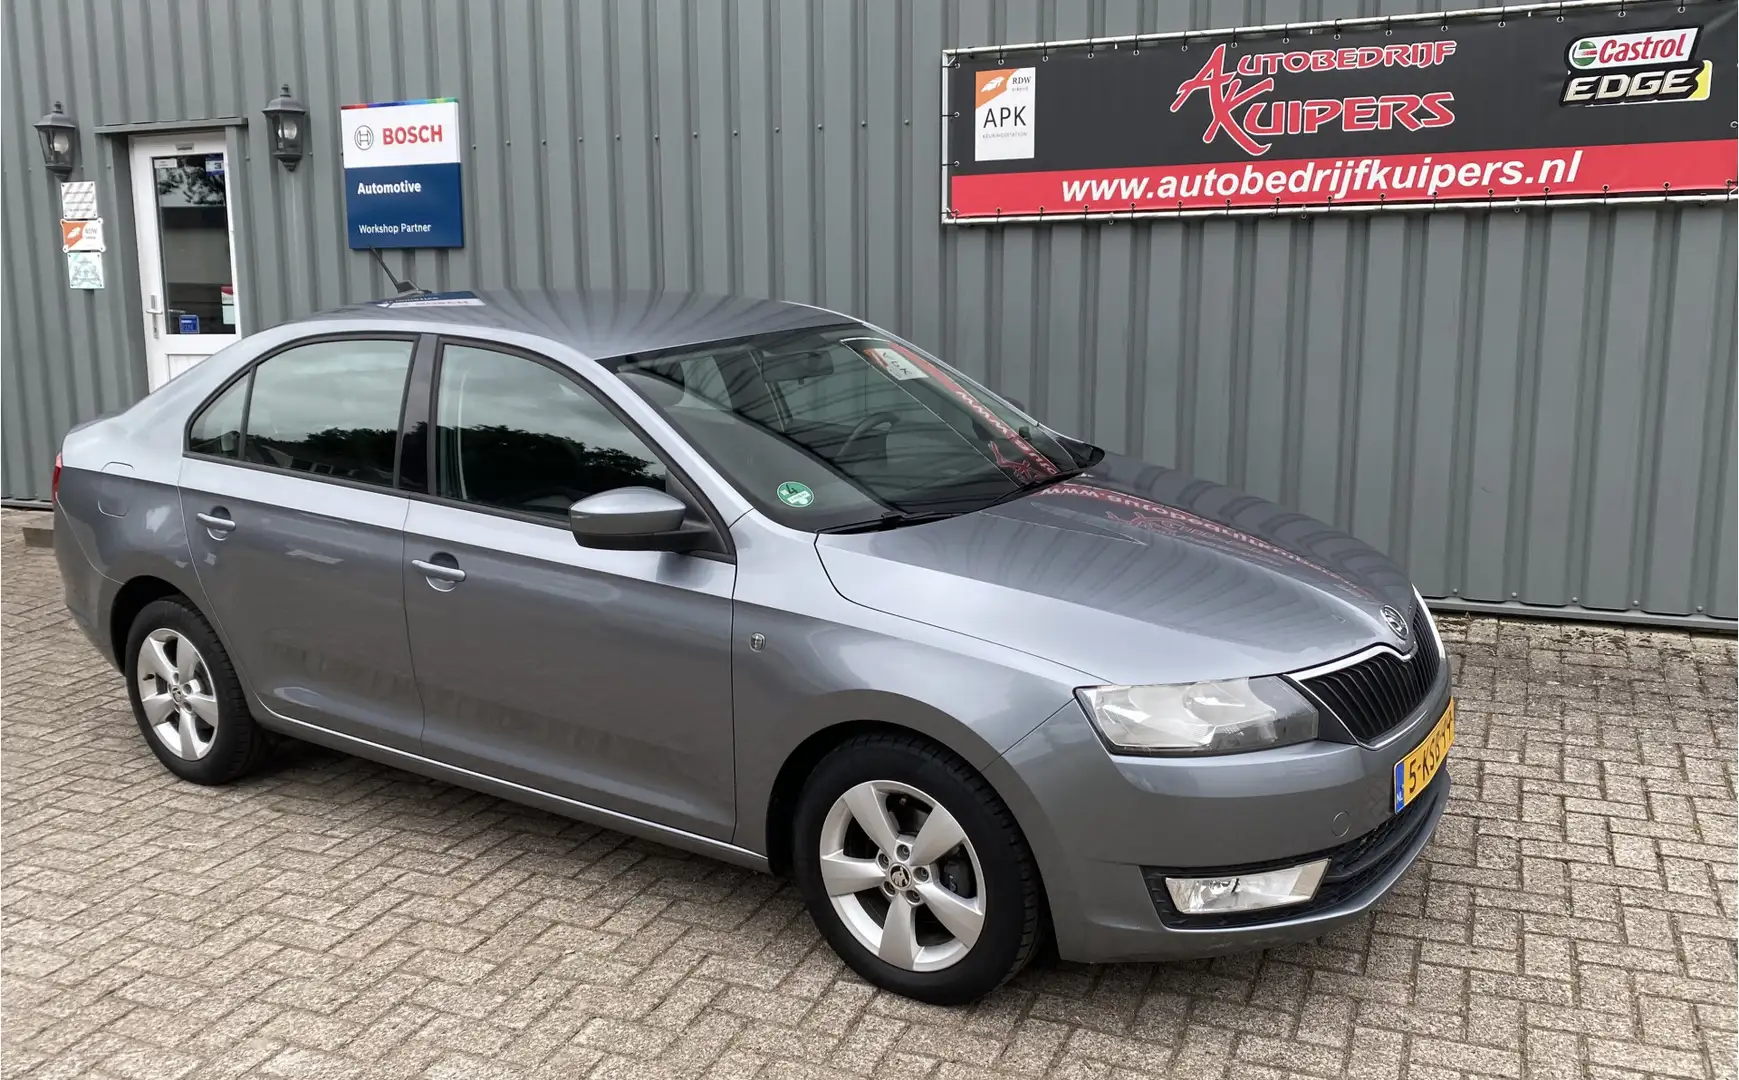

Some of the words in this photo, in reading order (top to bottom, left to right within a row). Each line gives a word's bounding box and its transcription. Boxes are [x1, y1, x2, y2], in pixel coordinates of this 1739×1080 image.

[1600, 33, 1687, 64] Castrol
[1012, 76, 1031, 85] RDW
[1170, 41, 1457, 112] AUTOBEDRIJF
[1563, 67, 1699, 102] EDGE
[983, 105, 1027, 128] APK
[1202, 78, 1456, 156] KUIPERS
[382, 124, 443, 146] BOSCH
[357, 179, 422, 195] Automotive
[1061, 150, 1583, 203] www.autobedrijfkuipers.nl
[358, 224, 399, 235] Workshop
[400, 223, 432, 234] Partner
